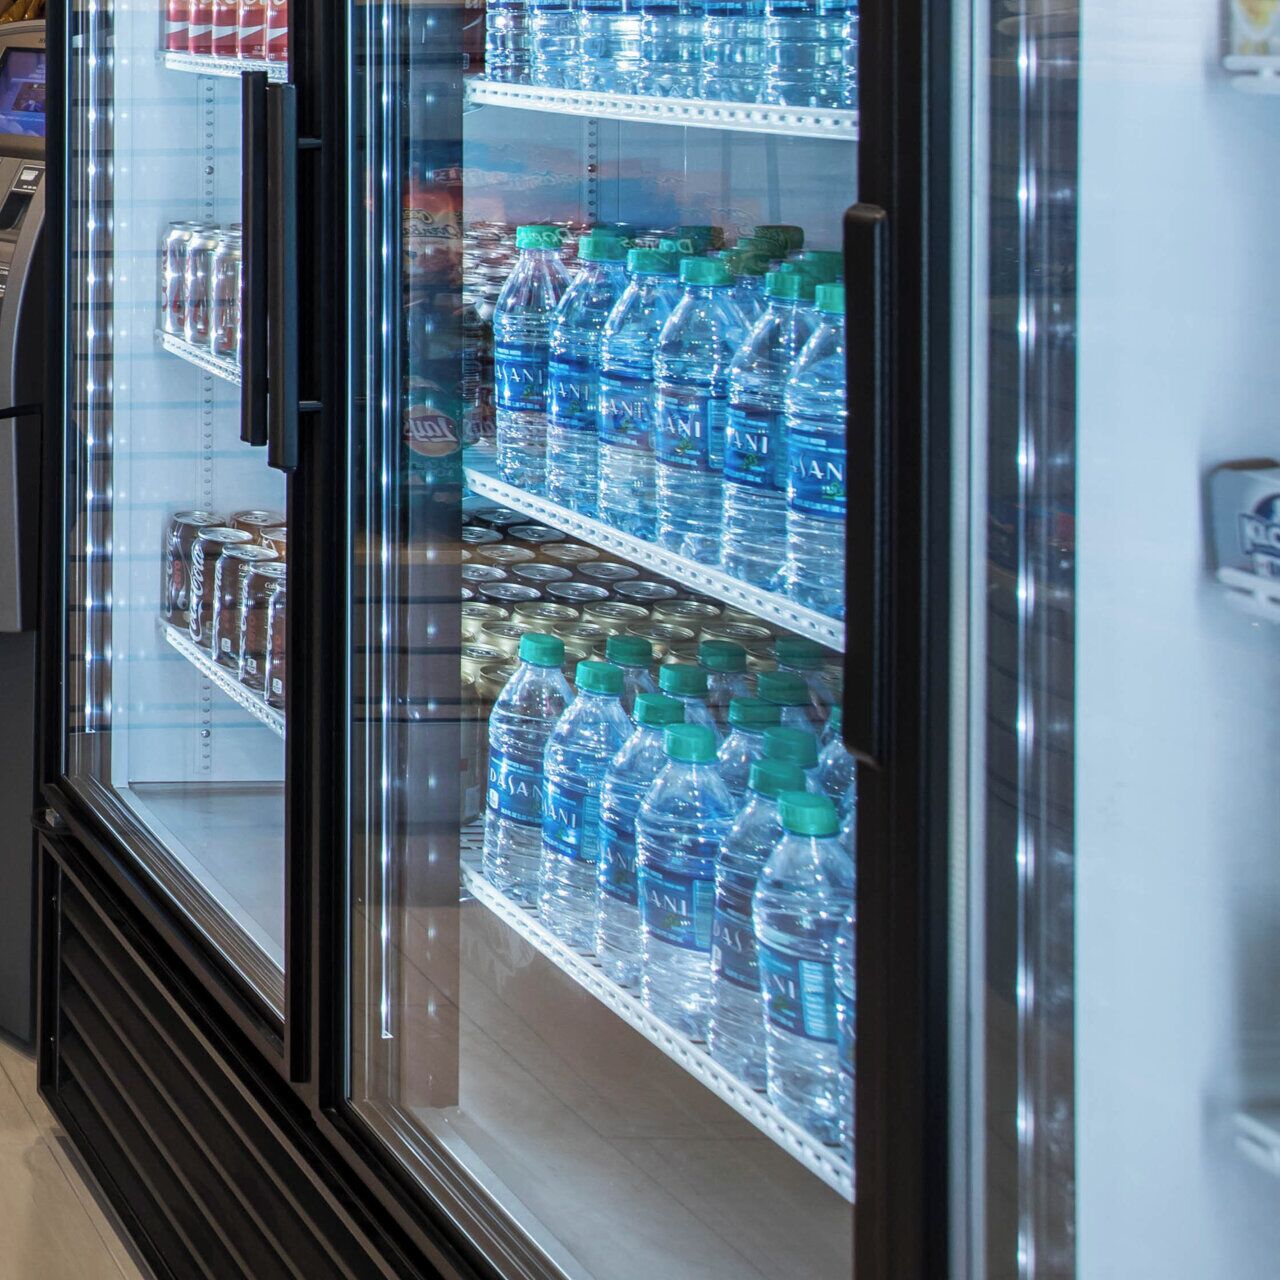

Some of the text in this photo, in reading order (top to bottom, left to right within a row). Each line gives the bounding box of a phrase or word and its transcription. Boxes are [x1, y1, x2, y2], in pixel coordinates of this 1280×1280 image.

[496, 363, 543, 385] ASANI
[662, 413, 702, 439] ANI
[490, 770, 543, 801] DASAN
